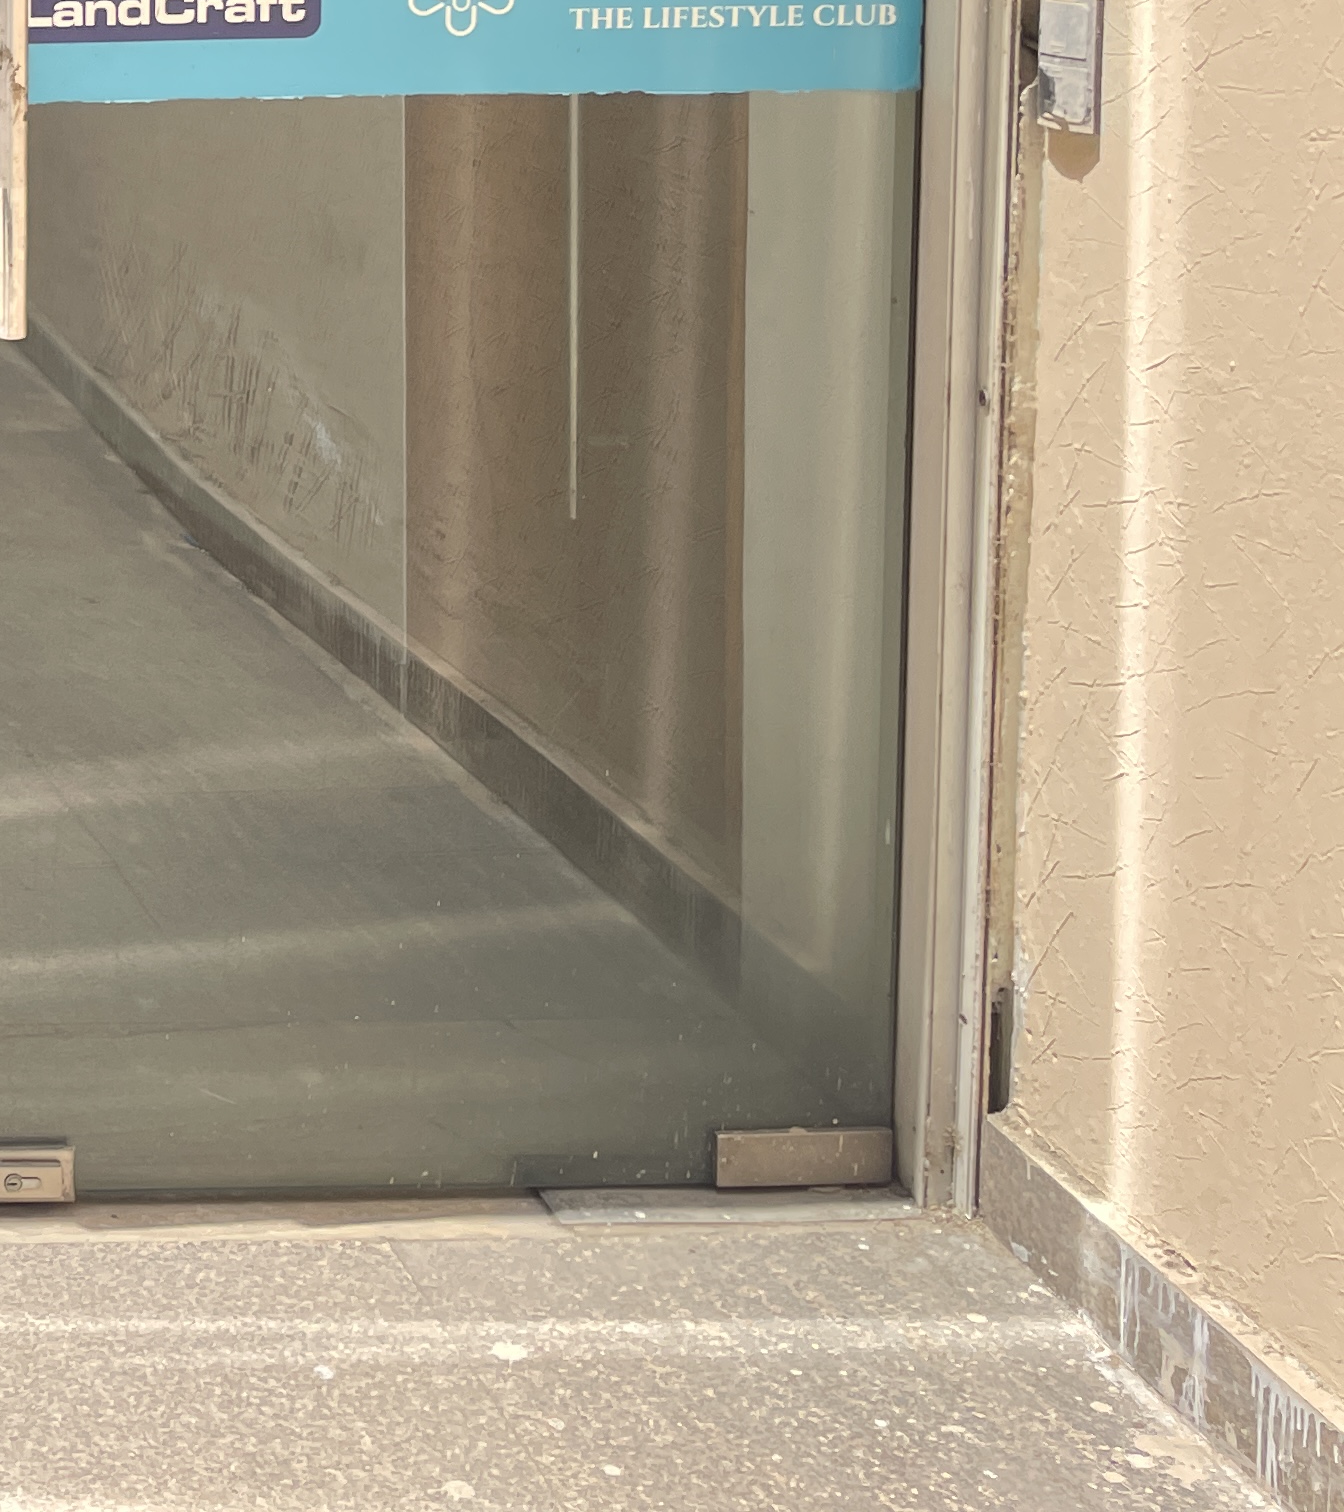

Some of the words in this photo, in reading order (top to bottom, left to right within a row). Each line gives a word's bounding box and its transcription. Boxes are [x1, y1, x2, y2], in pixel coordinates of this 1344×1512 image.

[569, 7, 634, 30] THE
[642, 4, 804, 29] LIFESTYLE
[812, 3, 897, 27] CLUB
